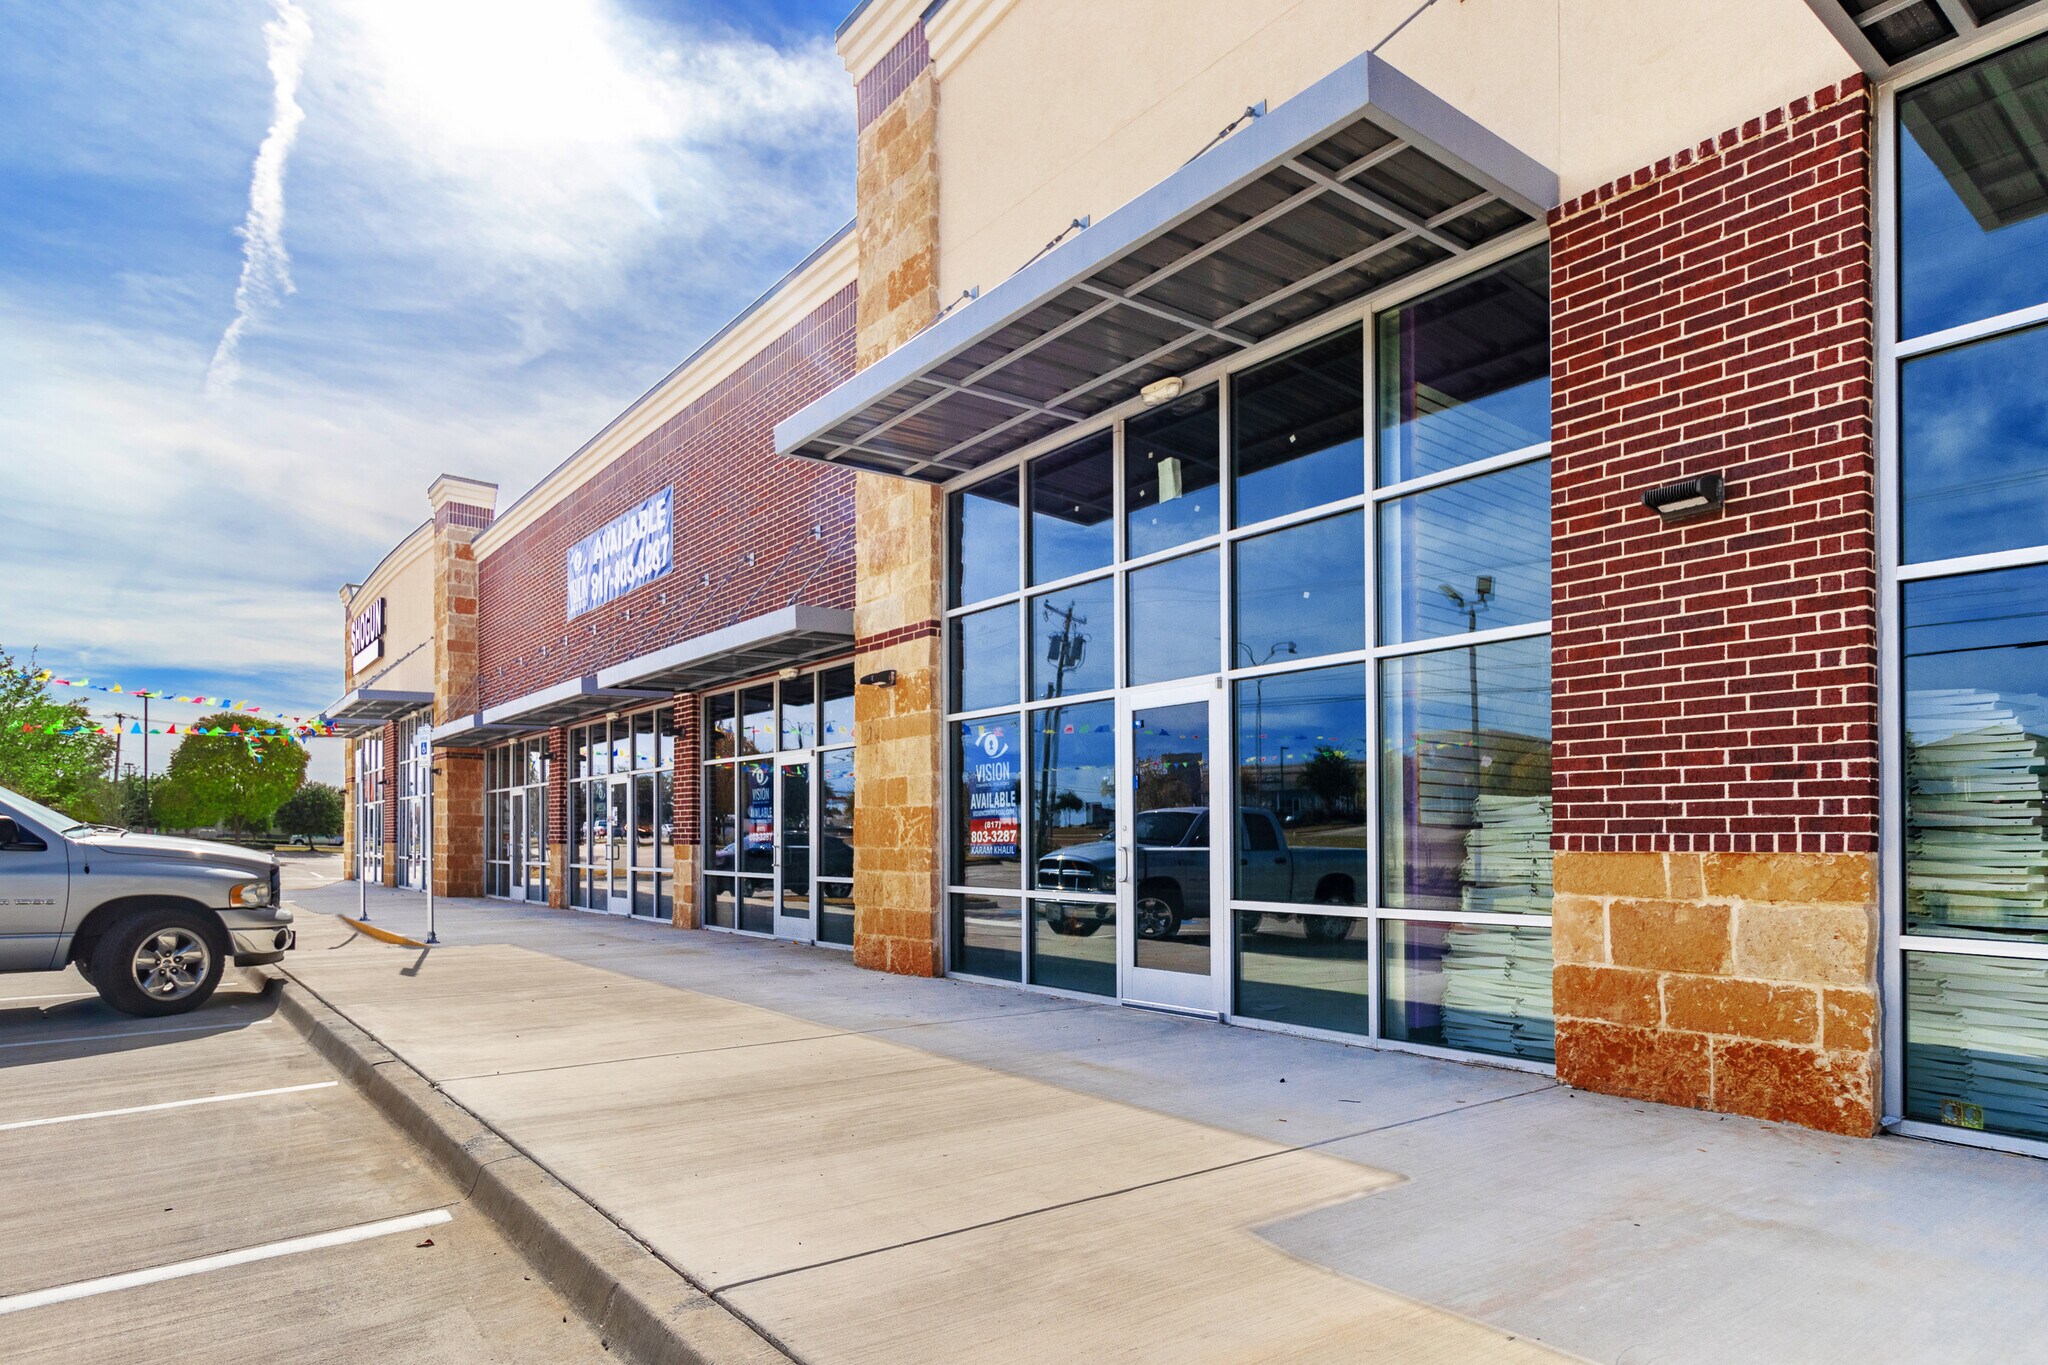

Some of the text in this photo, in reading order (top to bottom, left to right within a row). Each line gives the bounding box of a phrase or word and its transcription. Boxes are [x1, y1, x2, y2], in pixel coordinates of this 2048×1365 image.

[593, 497, 666, 564] AVAILABLE
[351, 597, 381, 657] SHOGUN
[976, 763, 1010, 782] VISION
[971, 791, 1015, 809] AVAILABLE
[984, 821, 1001, 829] (817)
[971, 830, 1016, 842] 803-3287
[970, 844, 1015, 855] KARAM KHALIL
